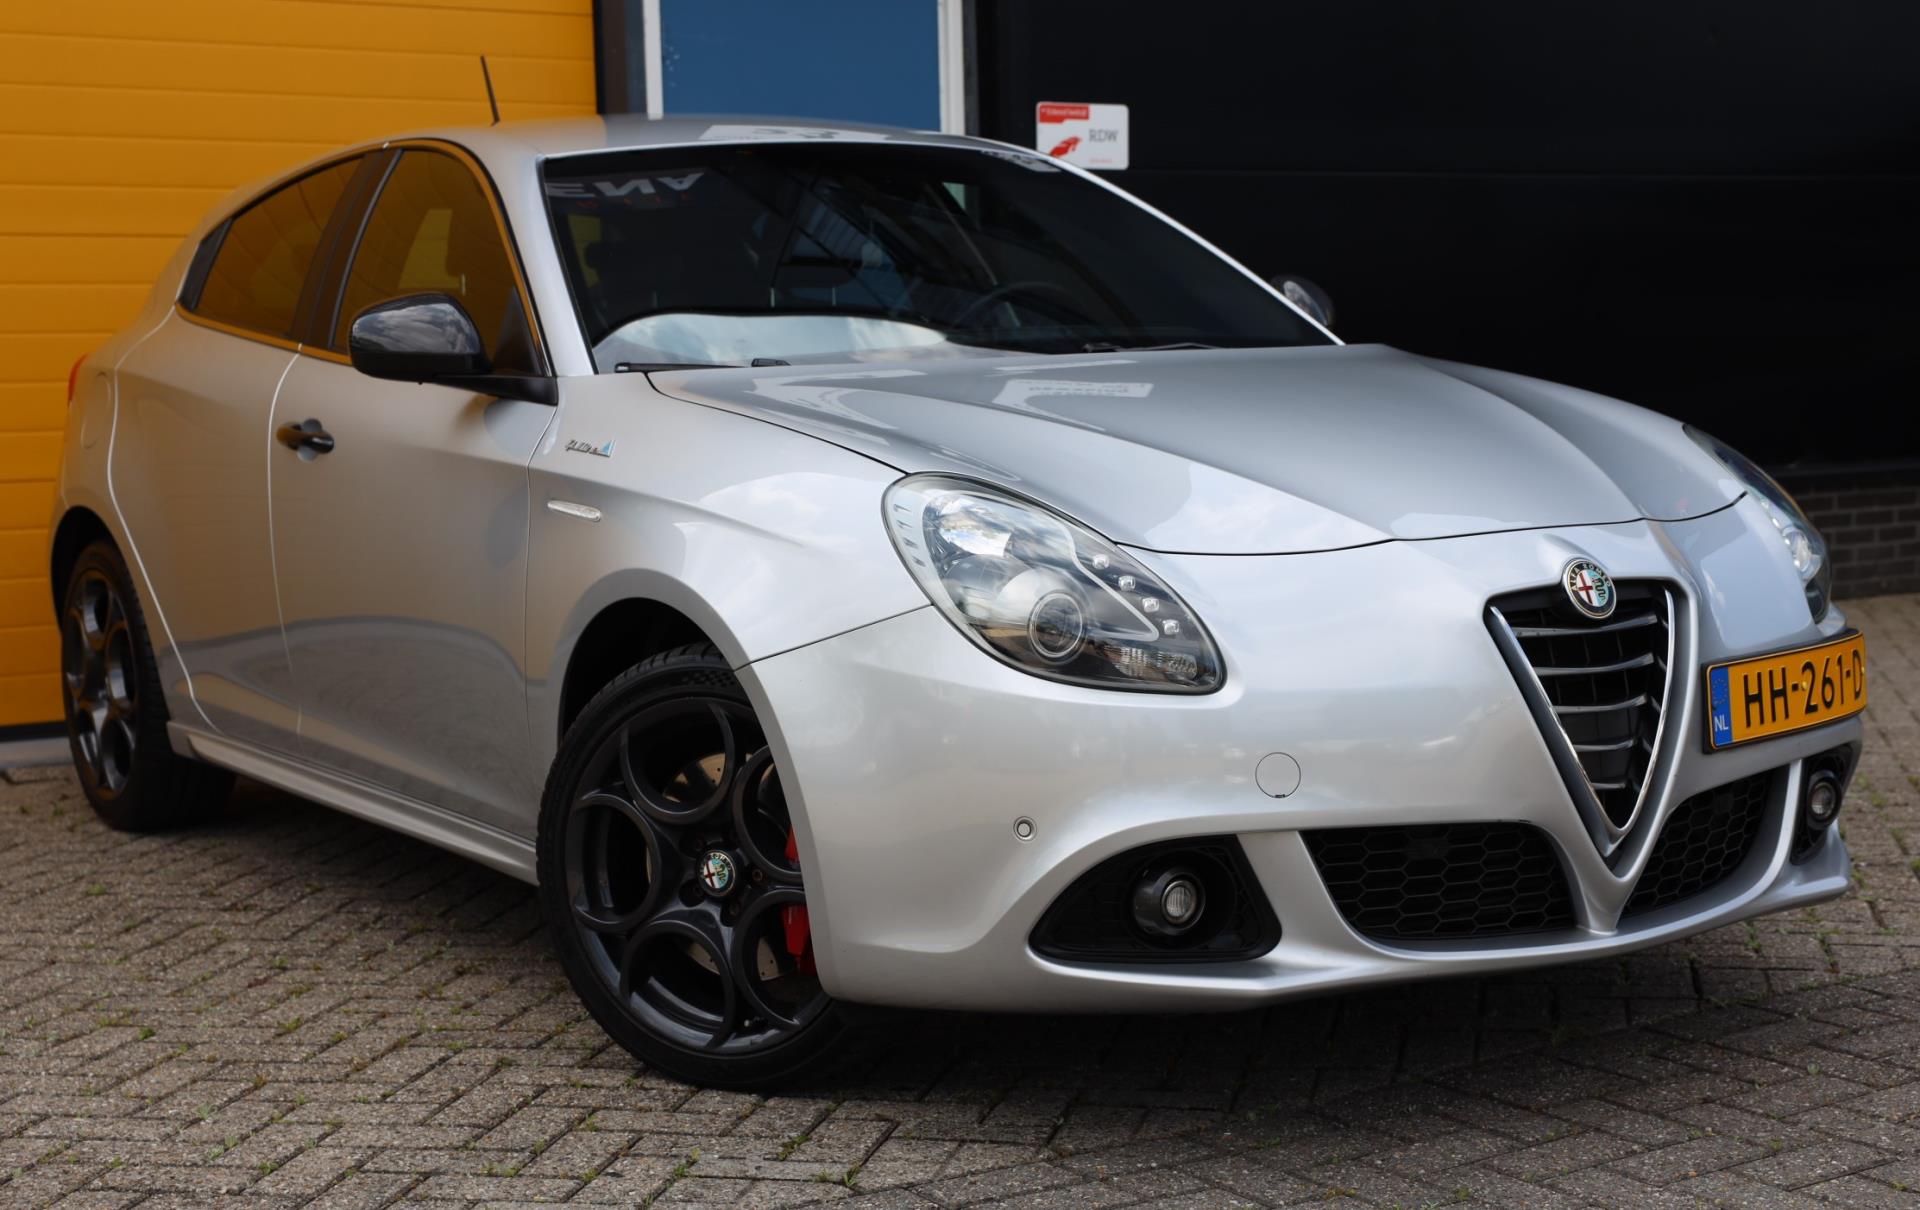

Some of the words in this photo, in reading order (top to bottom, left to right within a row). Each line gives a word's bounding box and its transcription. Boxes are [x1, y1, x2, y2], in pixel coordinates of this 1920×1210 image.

[1088, 129, 1119, 142] RDW
[1743, 649, 1862, 728] HH-261-D
[1714, 715, 1728, 732] NL
